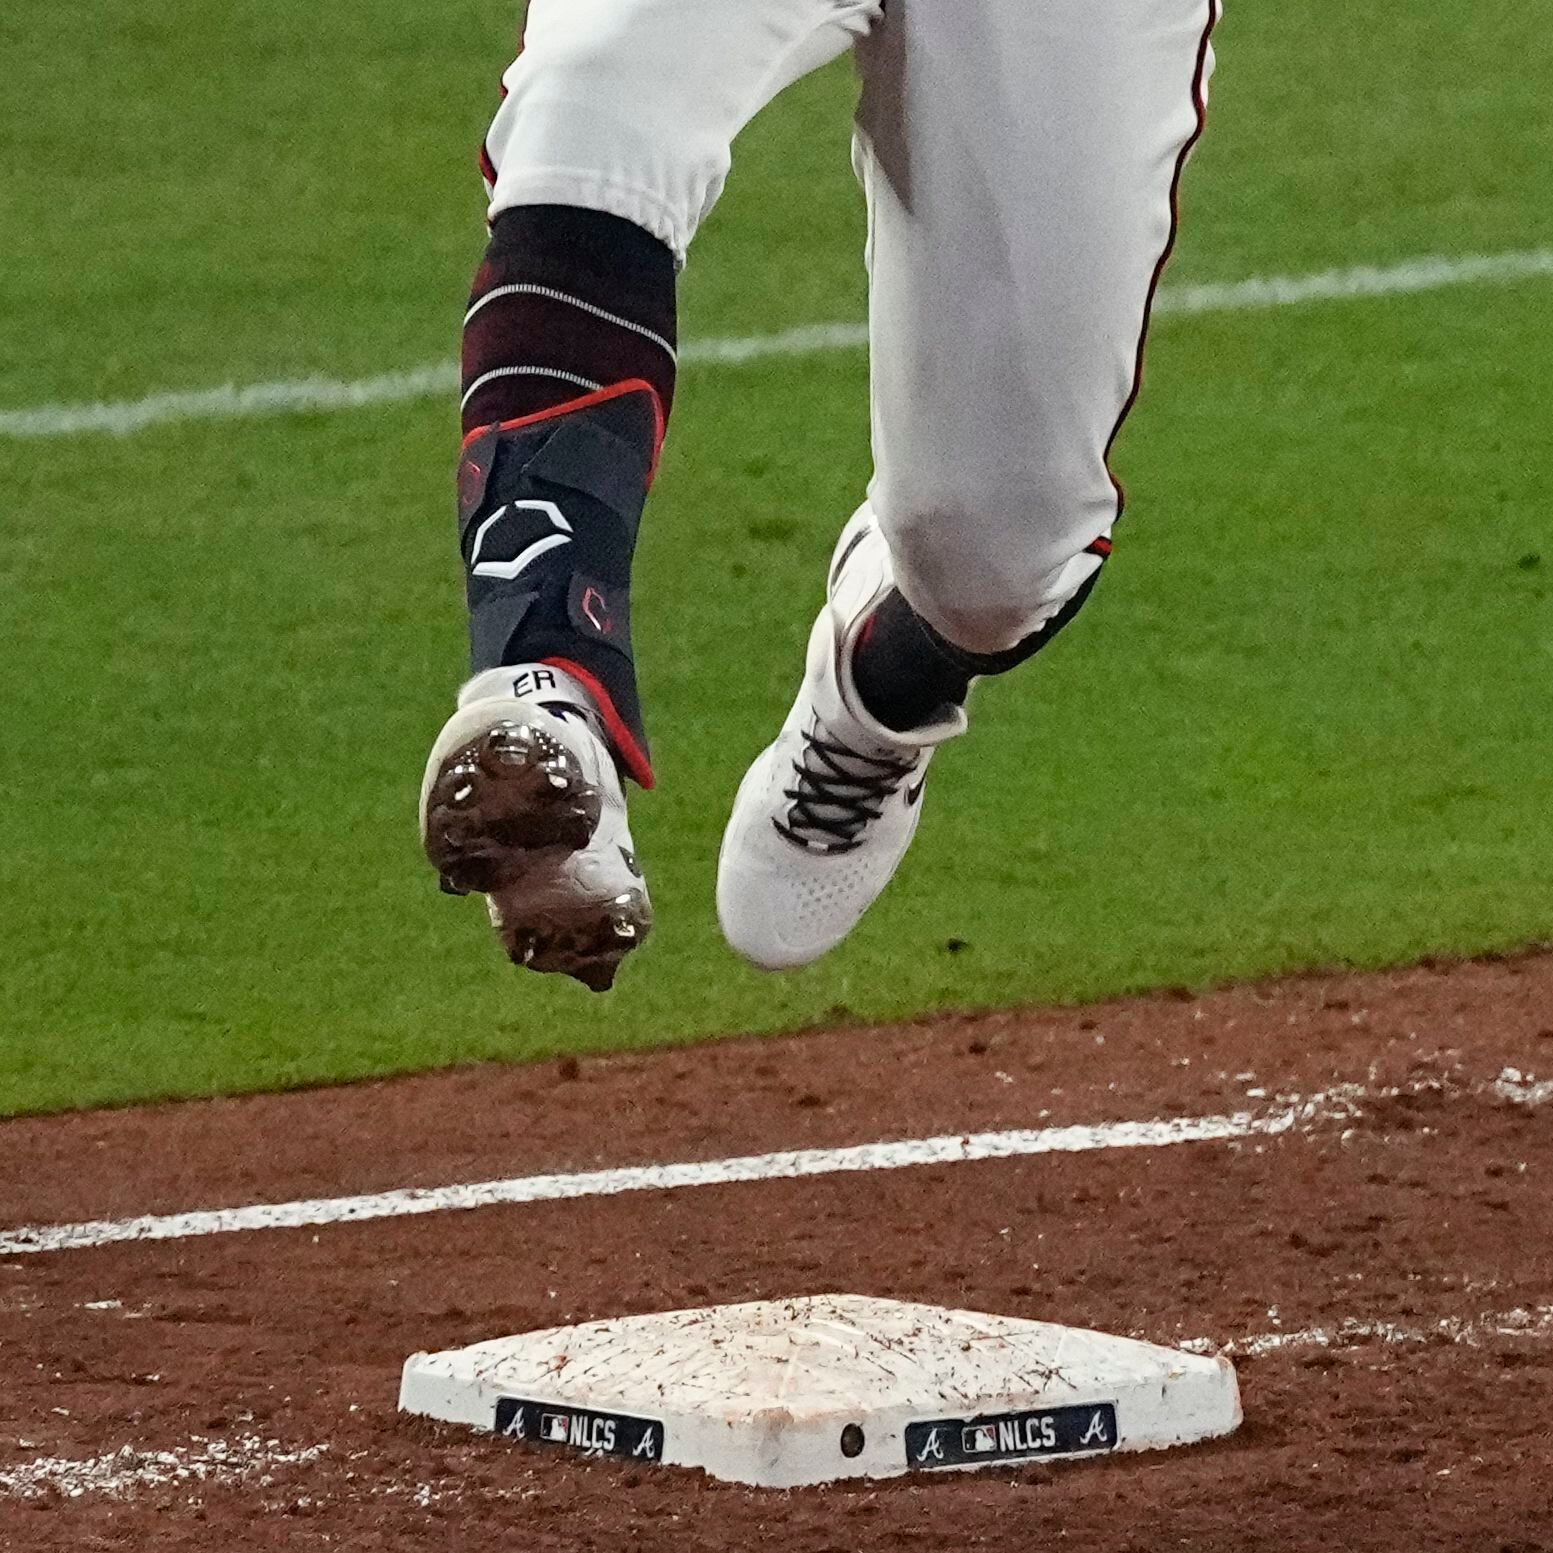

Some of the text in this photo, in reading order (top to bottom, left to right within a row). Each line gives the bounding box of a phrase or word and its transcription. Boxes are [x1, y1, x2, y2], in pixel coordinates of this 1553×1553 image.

[512, 670, 556, 698] ER
[569, 1414, 616, 1451] NLCS
[999, 1416, 1056, 1452] NLCS
